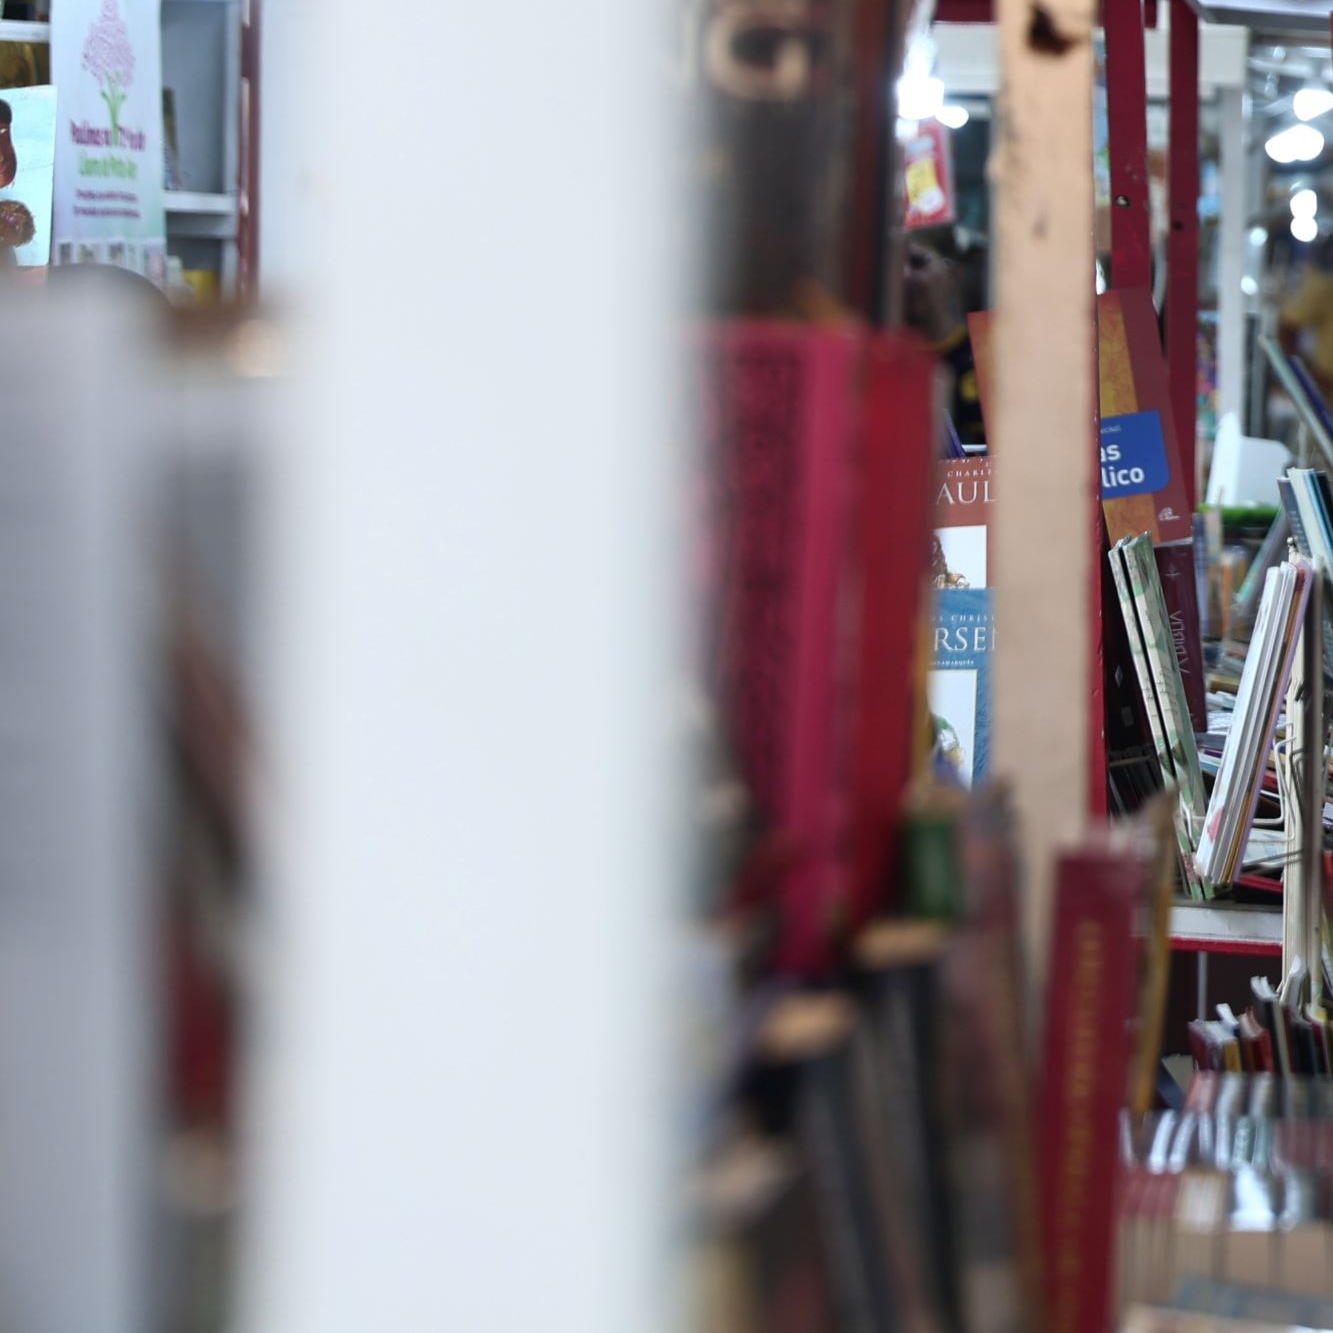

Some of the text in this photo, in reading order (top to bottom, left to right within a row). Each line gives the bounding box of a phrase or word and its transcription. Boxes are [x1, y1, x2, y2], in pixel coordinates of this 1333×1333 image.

[1101, 466, 1146, 488] lico
[935, 480, 999, 506] AUL
[950, 614, 995, 622] CHRIS
[933, 625, 997, 652] RSE
